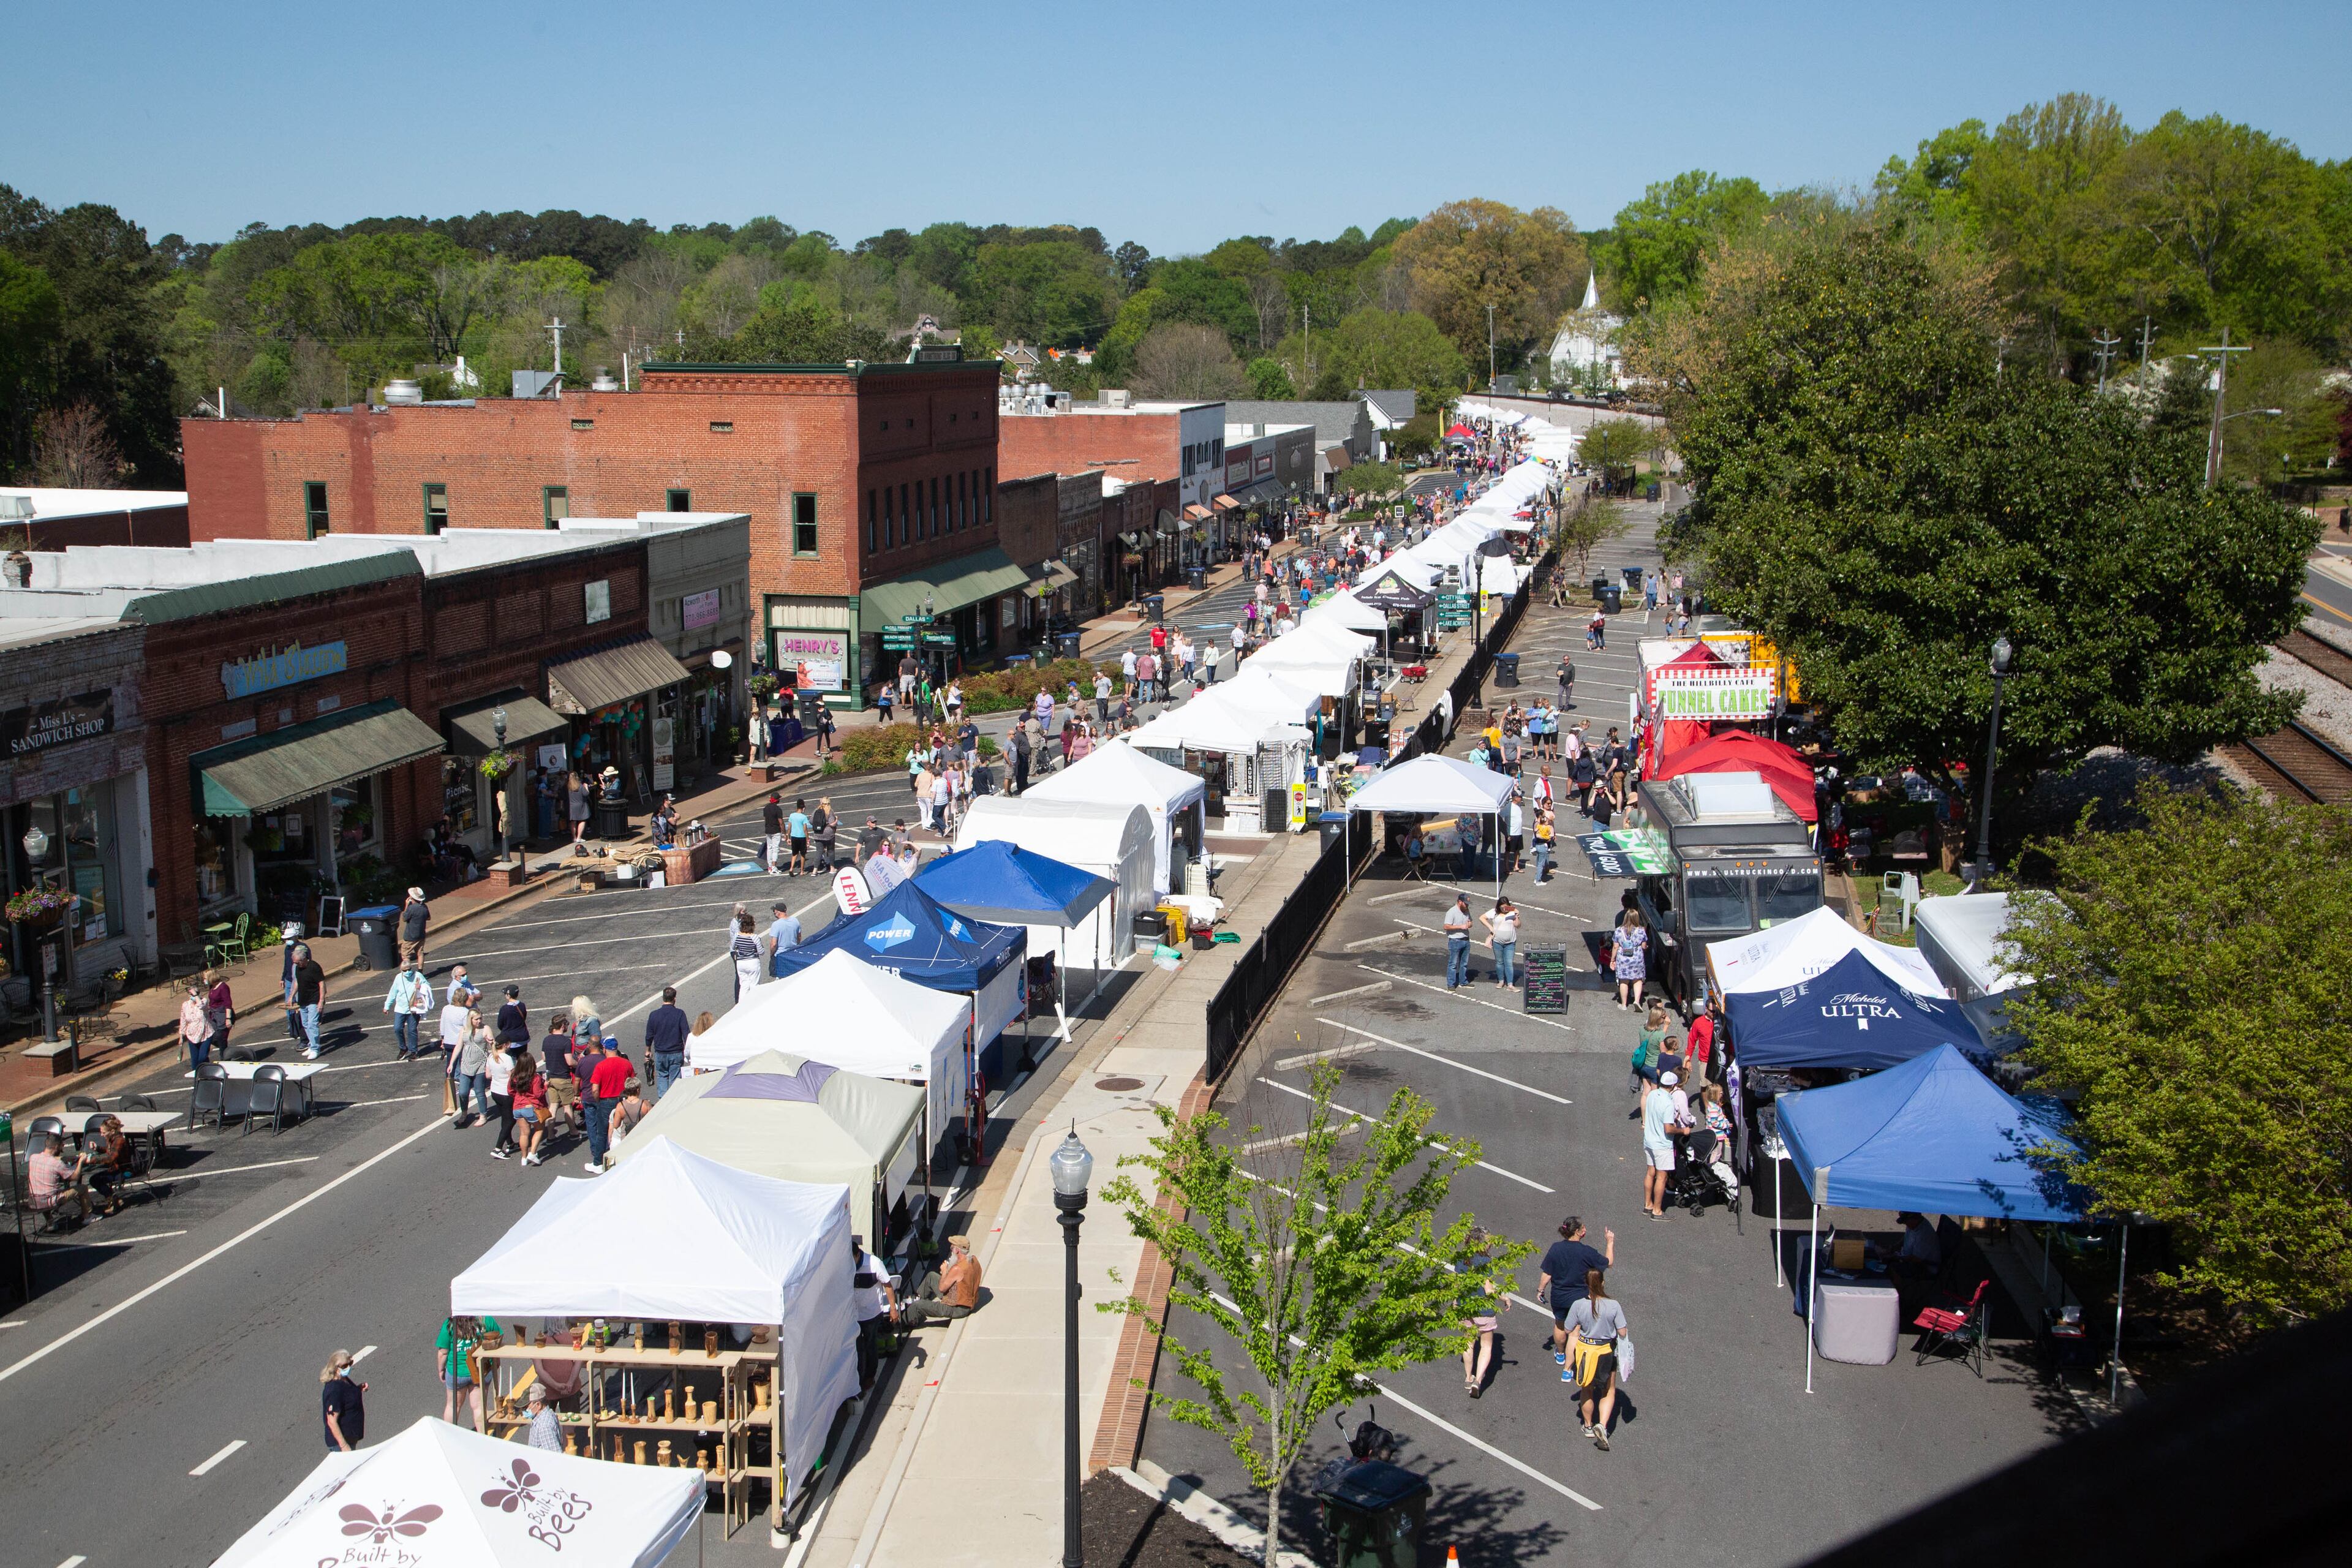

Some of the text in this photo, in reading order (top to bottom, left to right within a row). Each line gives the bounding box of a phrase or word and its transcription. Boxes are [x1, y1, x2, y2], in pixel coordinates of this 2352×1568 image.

[785, 638, 839, 654] HENRY'S
[237, 644, 279, 690] Wild
[1658, 688, 1768, 713] FUNNEL CAKES
[39, 710, 75, 730] Miss L's
[11, 718, 104, 753] SANDWICH SHOP
[1599, 856, 1623, 873] GOOD
[867, 929, 911, 940] POWER
[949, 919, 962, 937] POWER
[996, 947, 1011, 967] POWER
[1747, 944, 1760, 963] ULTRA
[1779, 986, 1797, 1008] ULTRA
[1830, 992, 1887, 1005] Michelob
[1820, 1005, 1902, 1019] ULTRA
[527, 1487, 573, 1526] Built by
[528, 1493, 593, 1552] Bees
[342, 1546, 391, 1564] Built
[398, 1545, 422, 1565] by
